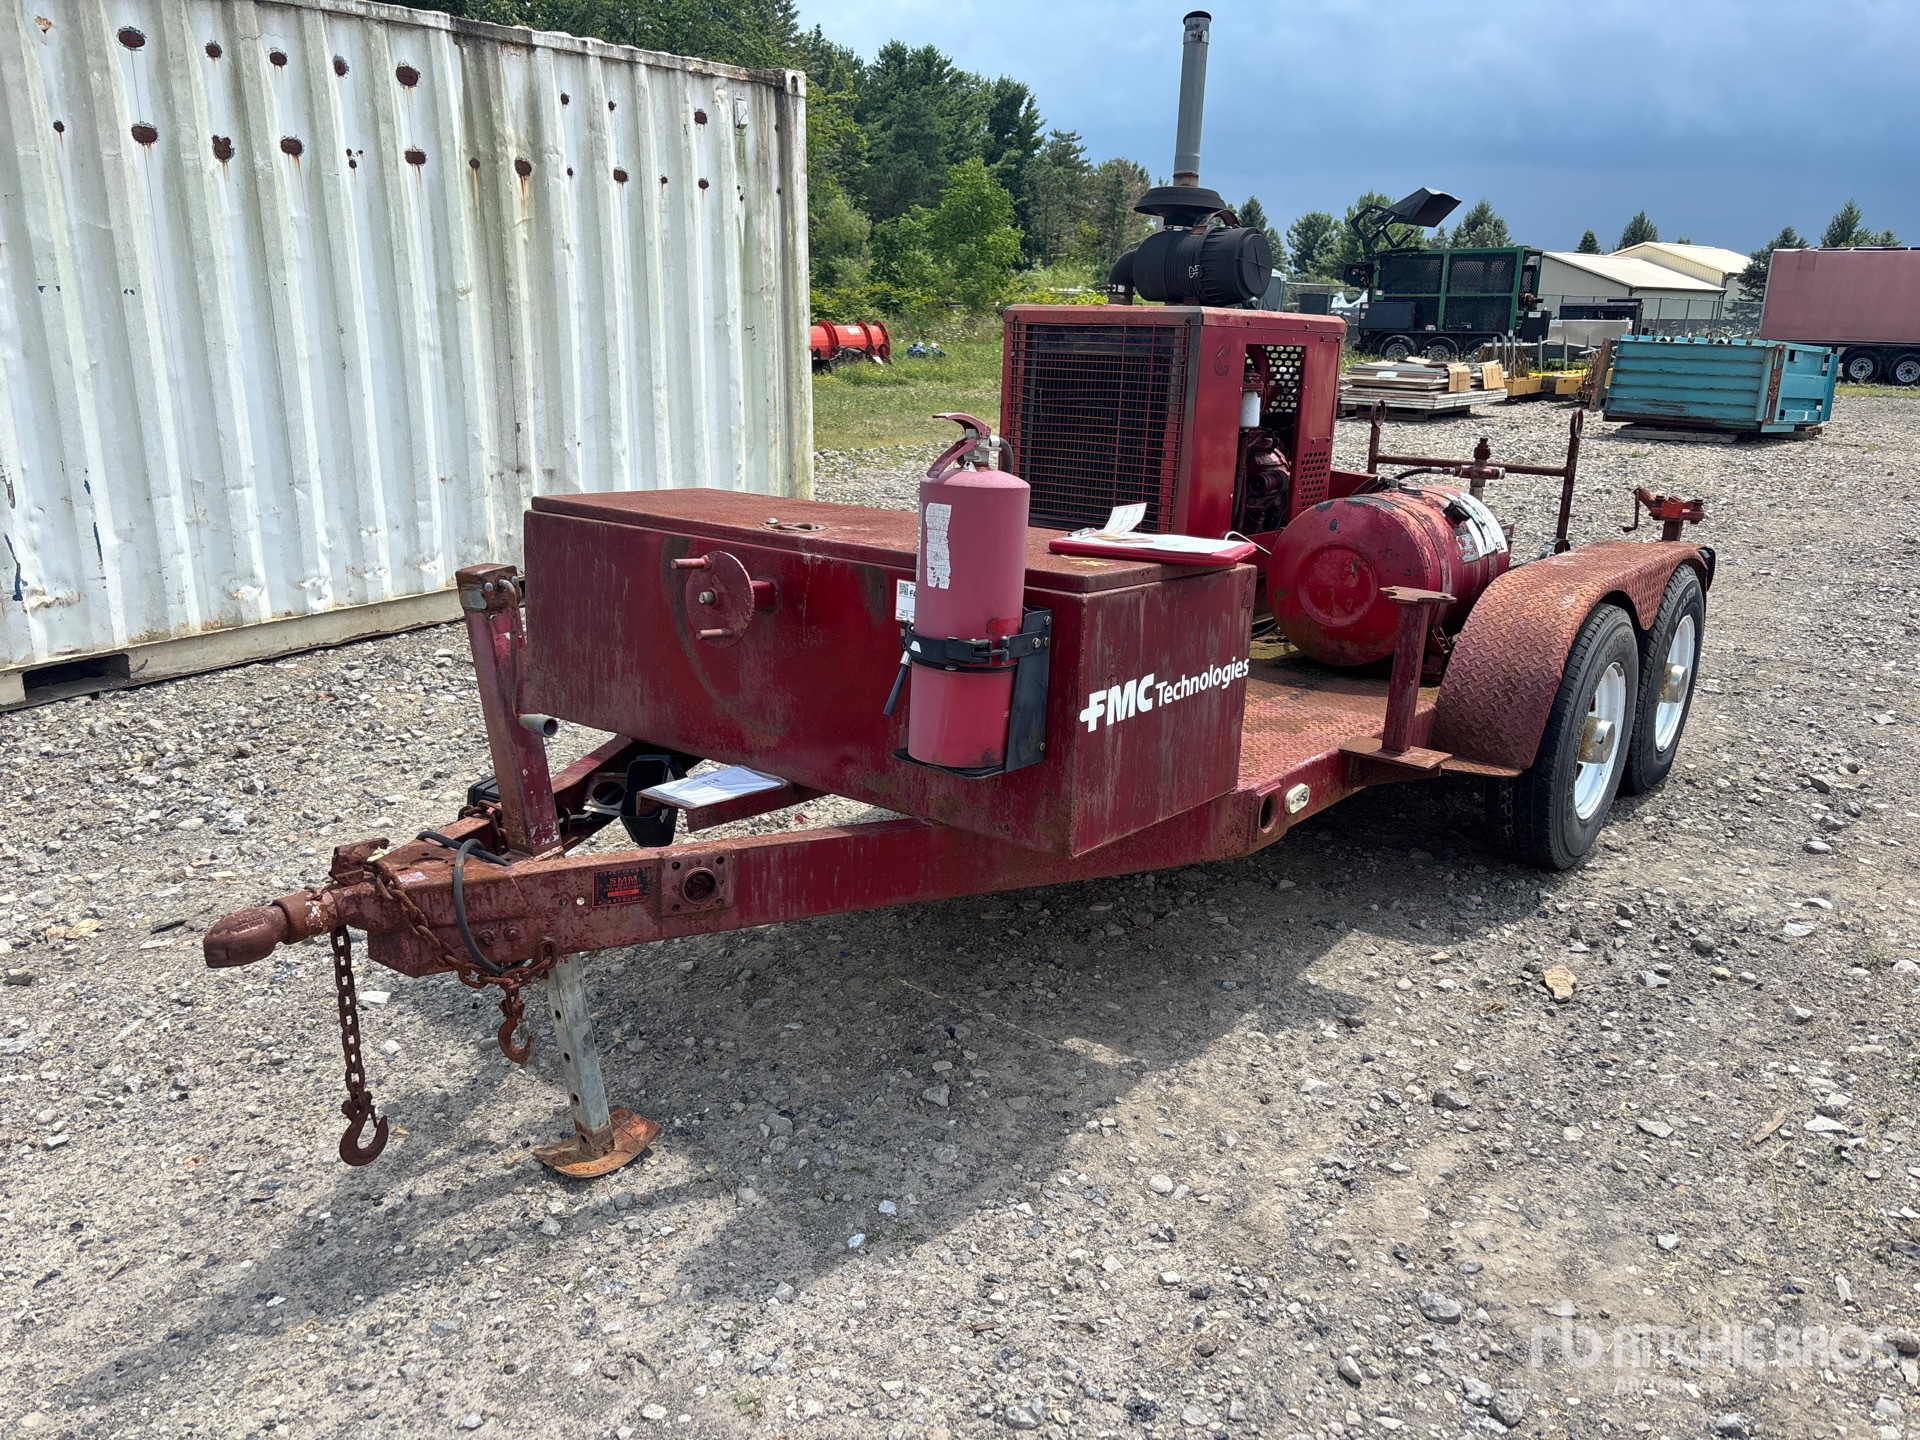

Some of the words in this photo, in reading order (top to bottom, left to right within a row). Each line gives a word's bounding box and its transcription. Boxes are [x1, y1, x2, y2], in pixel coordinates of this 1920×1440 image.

[1080, 673, 1154, 732] FMC
[1155, 656, 1249, 707] Technologies
[610, 875, 638, 884] SMM
